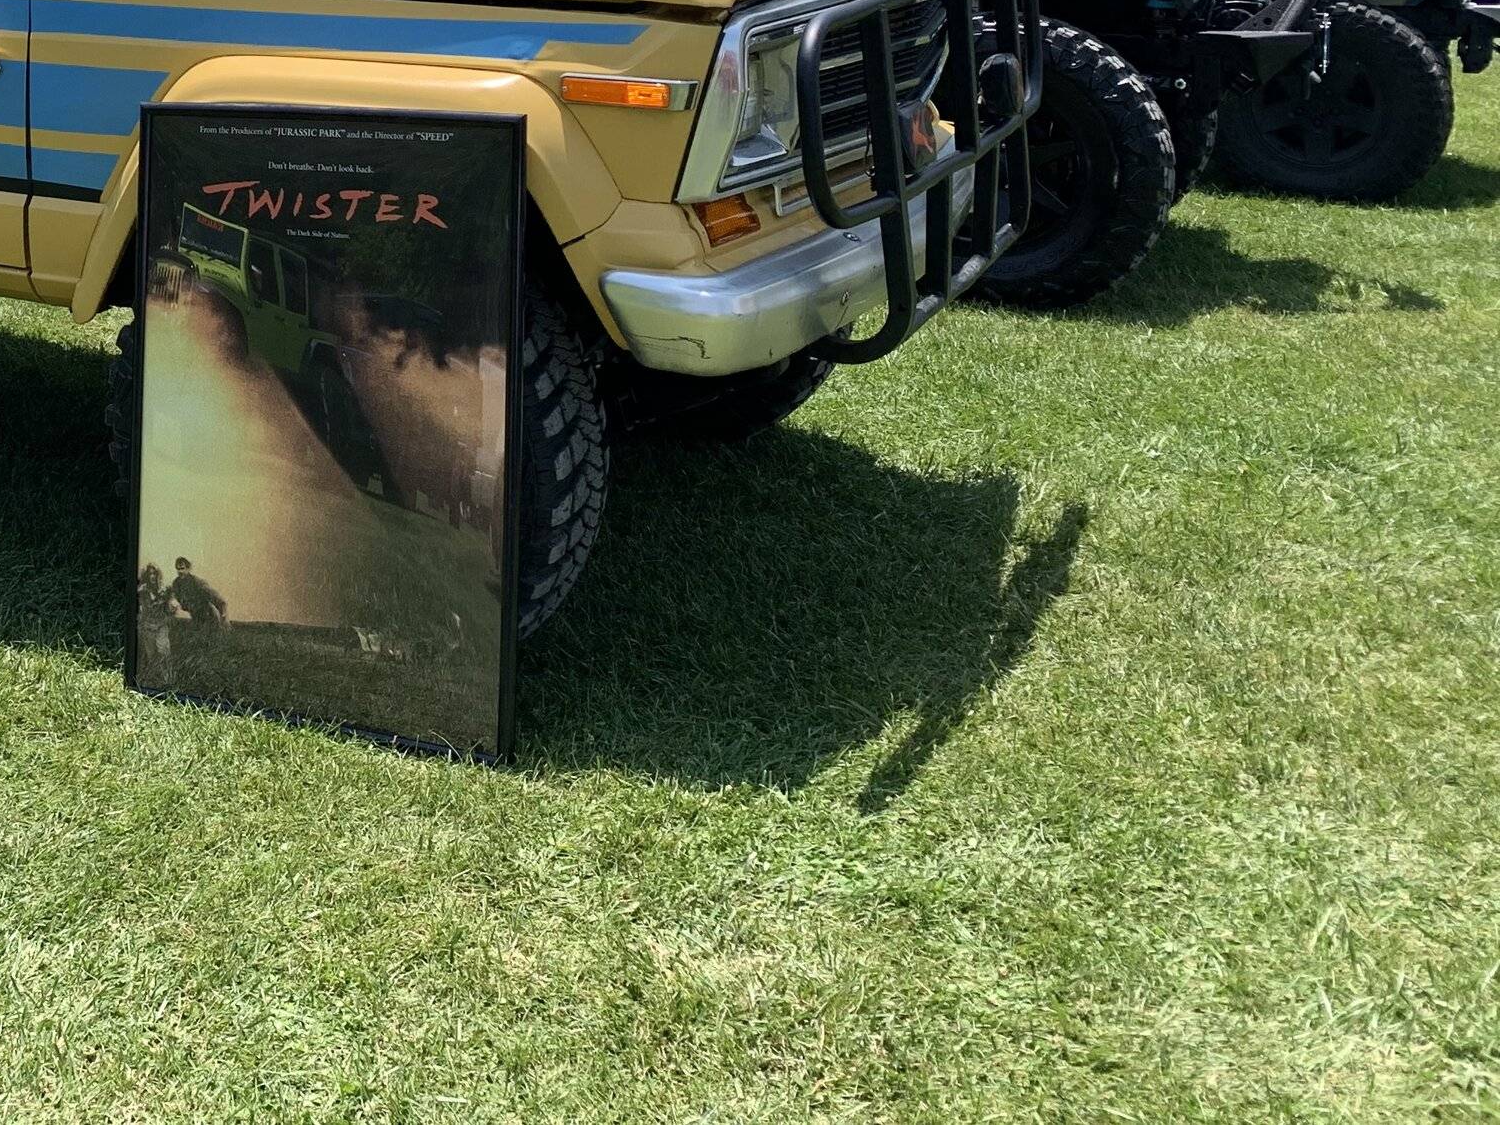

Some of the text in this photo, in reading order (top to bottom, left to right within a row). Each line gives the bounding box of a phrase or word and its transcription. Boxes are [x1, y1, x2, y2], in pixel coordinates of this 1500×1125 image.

[200, 125, 217, 134] From
[219, 126, 229, 135] the
[231, 126, 263, 136] Producers
[265, 127, 273, 135] of
[347, 130, 360, 139] and
[362, 130, 373, 139] the
[375, 131, 404, 140] Director
[406, 132, 414, 140] of
[338, 164, 355, 173] look
[202, 180, 449, 230] TWISTER
[286, 228, 297, 236] The
[297, 229, 311, 237] Dark
